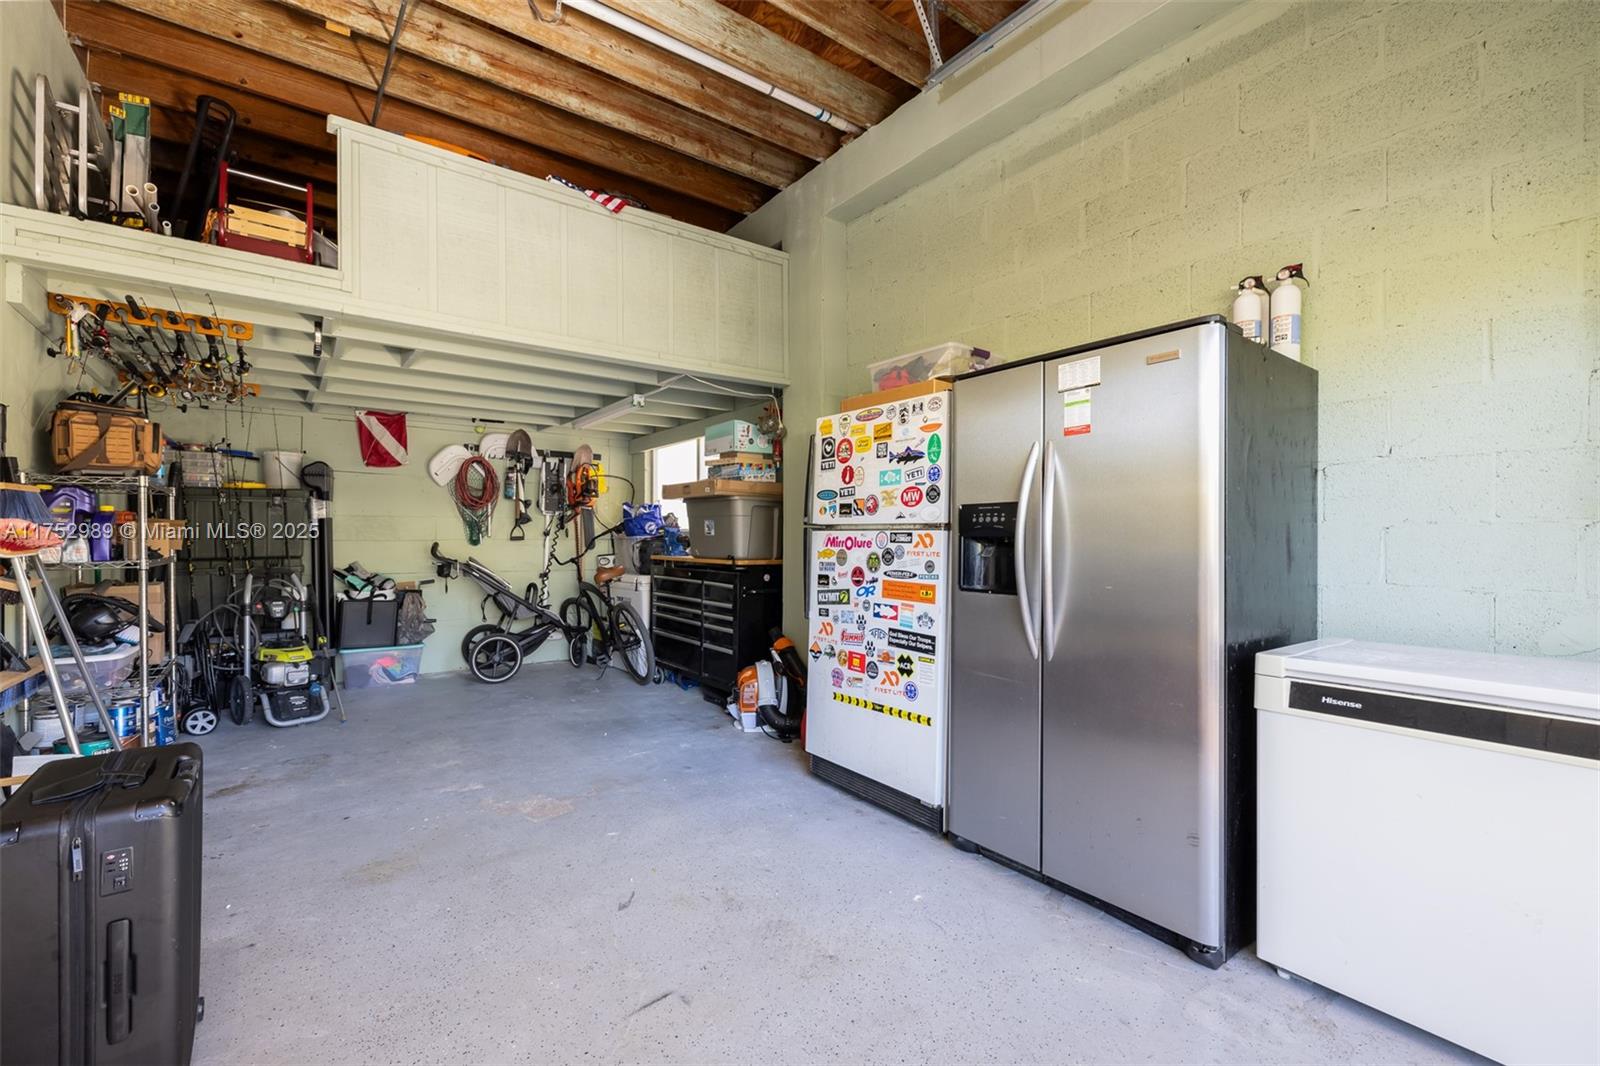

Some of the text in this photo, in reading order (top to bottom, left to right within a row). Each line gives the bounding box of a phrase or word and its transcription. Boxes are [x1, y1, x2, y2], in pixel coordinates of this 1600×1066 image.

[822, 461, 834, 470] YETI
[907, 470, 923, 480] YETI
[841, 488, 854, 497] YETI
[902, 491, 921, 502] MW
[825, 536, 872, 550] MirrOlure
[819, 593, 840, 602] KLYMIT
[875, 687, 892, 695] FIRST
[1321, 696, 1363, 709] Hisense
